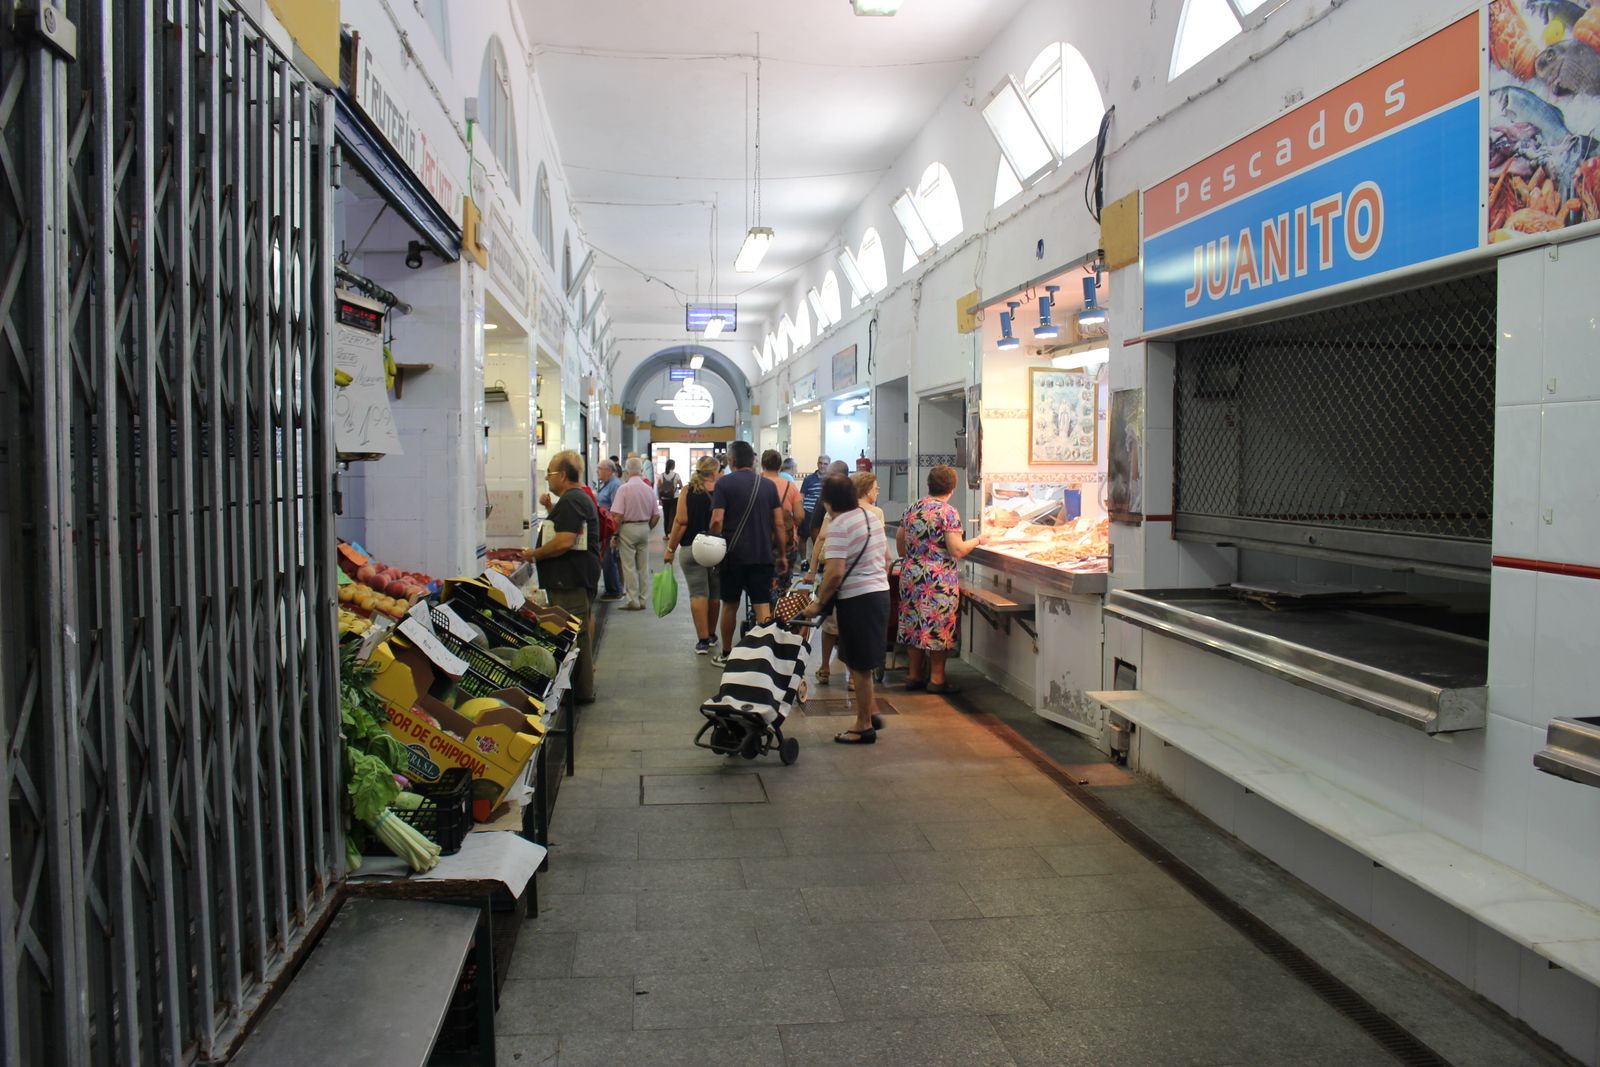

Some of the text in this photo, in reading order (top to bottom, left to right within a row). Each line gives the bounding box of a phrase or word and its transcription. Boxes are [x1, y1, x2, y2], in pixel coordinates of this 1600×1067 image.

[1184, 179, 1385, 309] JUANITO
[411, 723, 431, 743] DE
[429, 735, 486, 778] CHIPIONA
